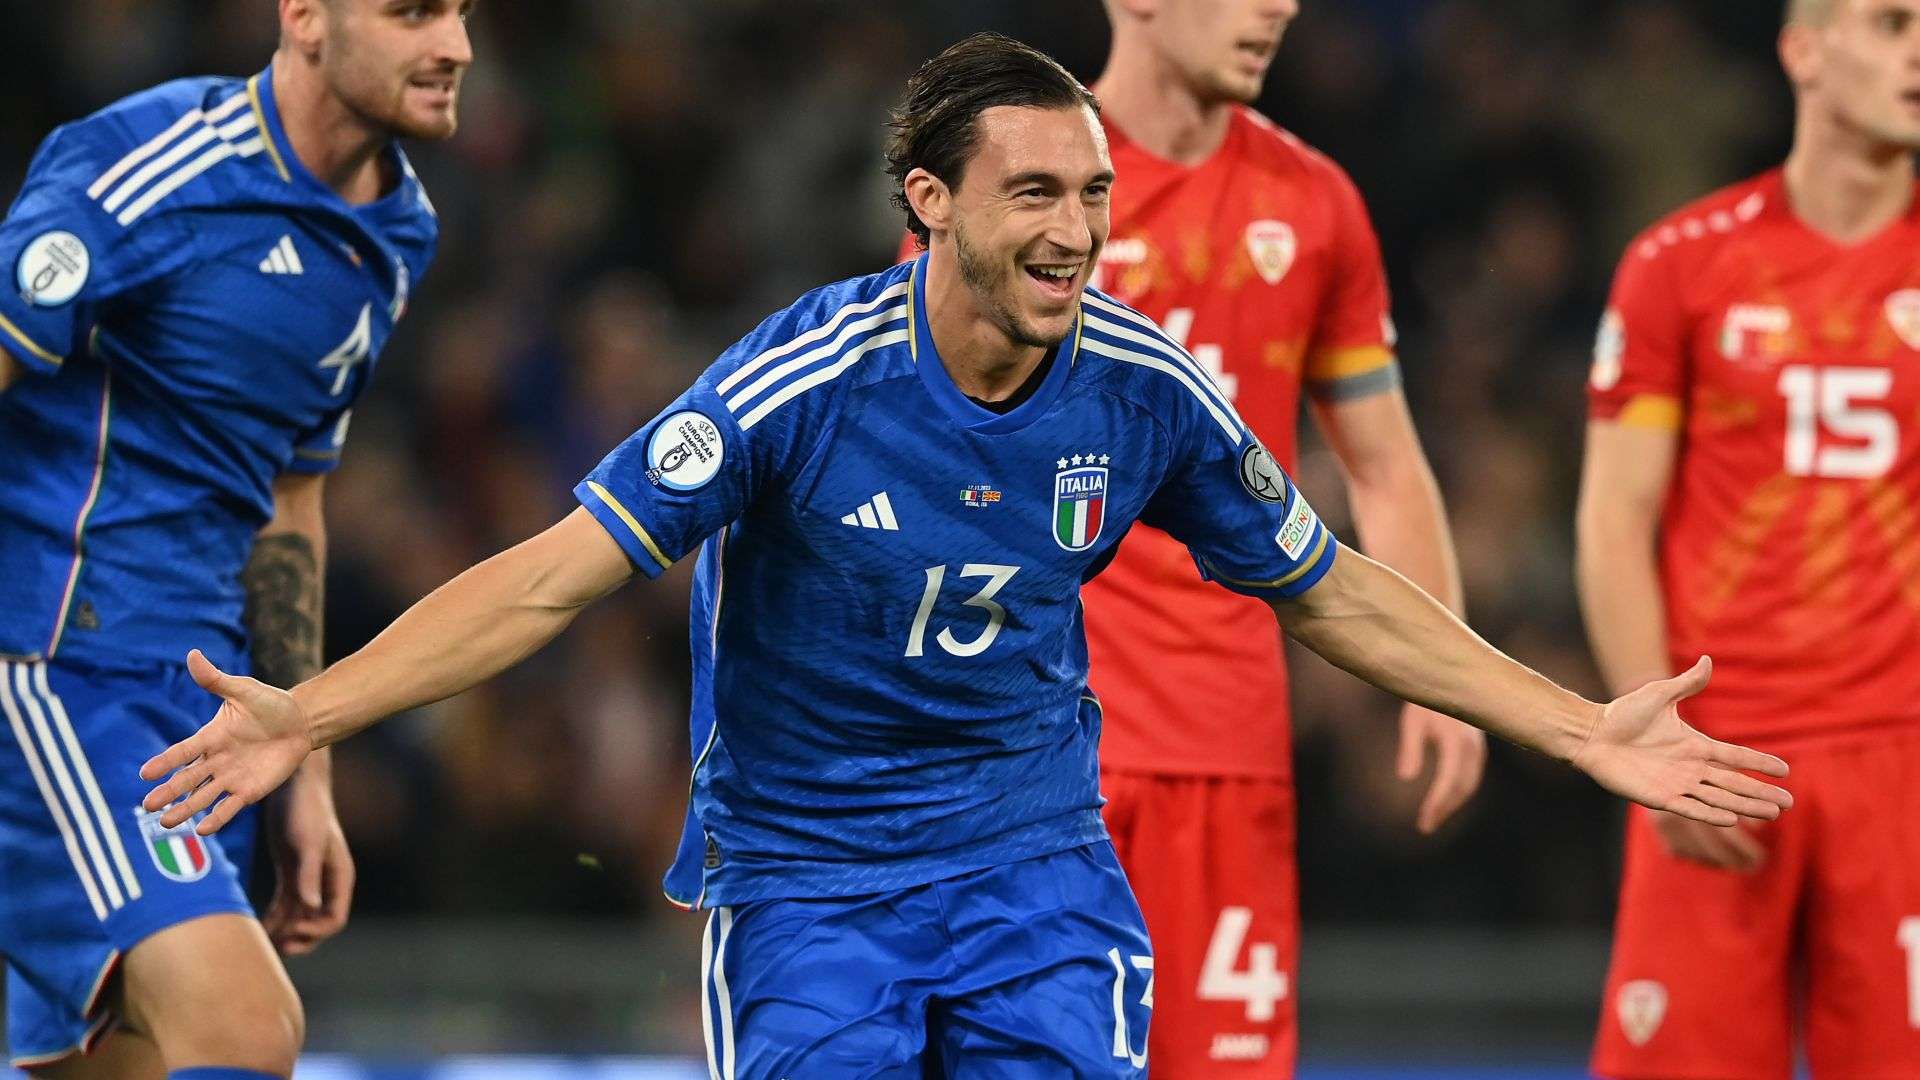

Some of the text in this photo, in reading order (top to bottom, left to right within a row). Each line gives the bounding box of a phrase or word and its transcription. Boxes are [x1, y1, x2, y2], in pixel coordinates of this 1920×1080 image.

[318, 301, 372, 397] 4
[678, 426, 708, 464] CHAMPIONS
[684, 420, 714, 459] EUROPEAN
[1778, 364, 1899, 479] 15
[645, 469, 659, 486] 2020
[1060, 474, 1104, 494] ITALIA
[904, 563, 1021, 657] 13
[1197, 905, 1288, 1021] 4
